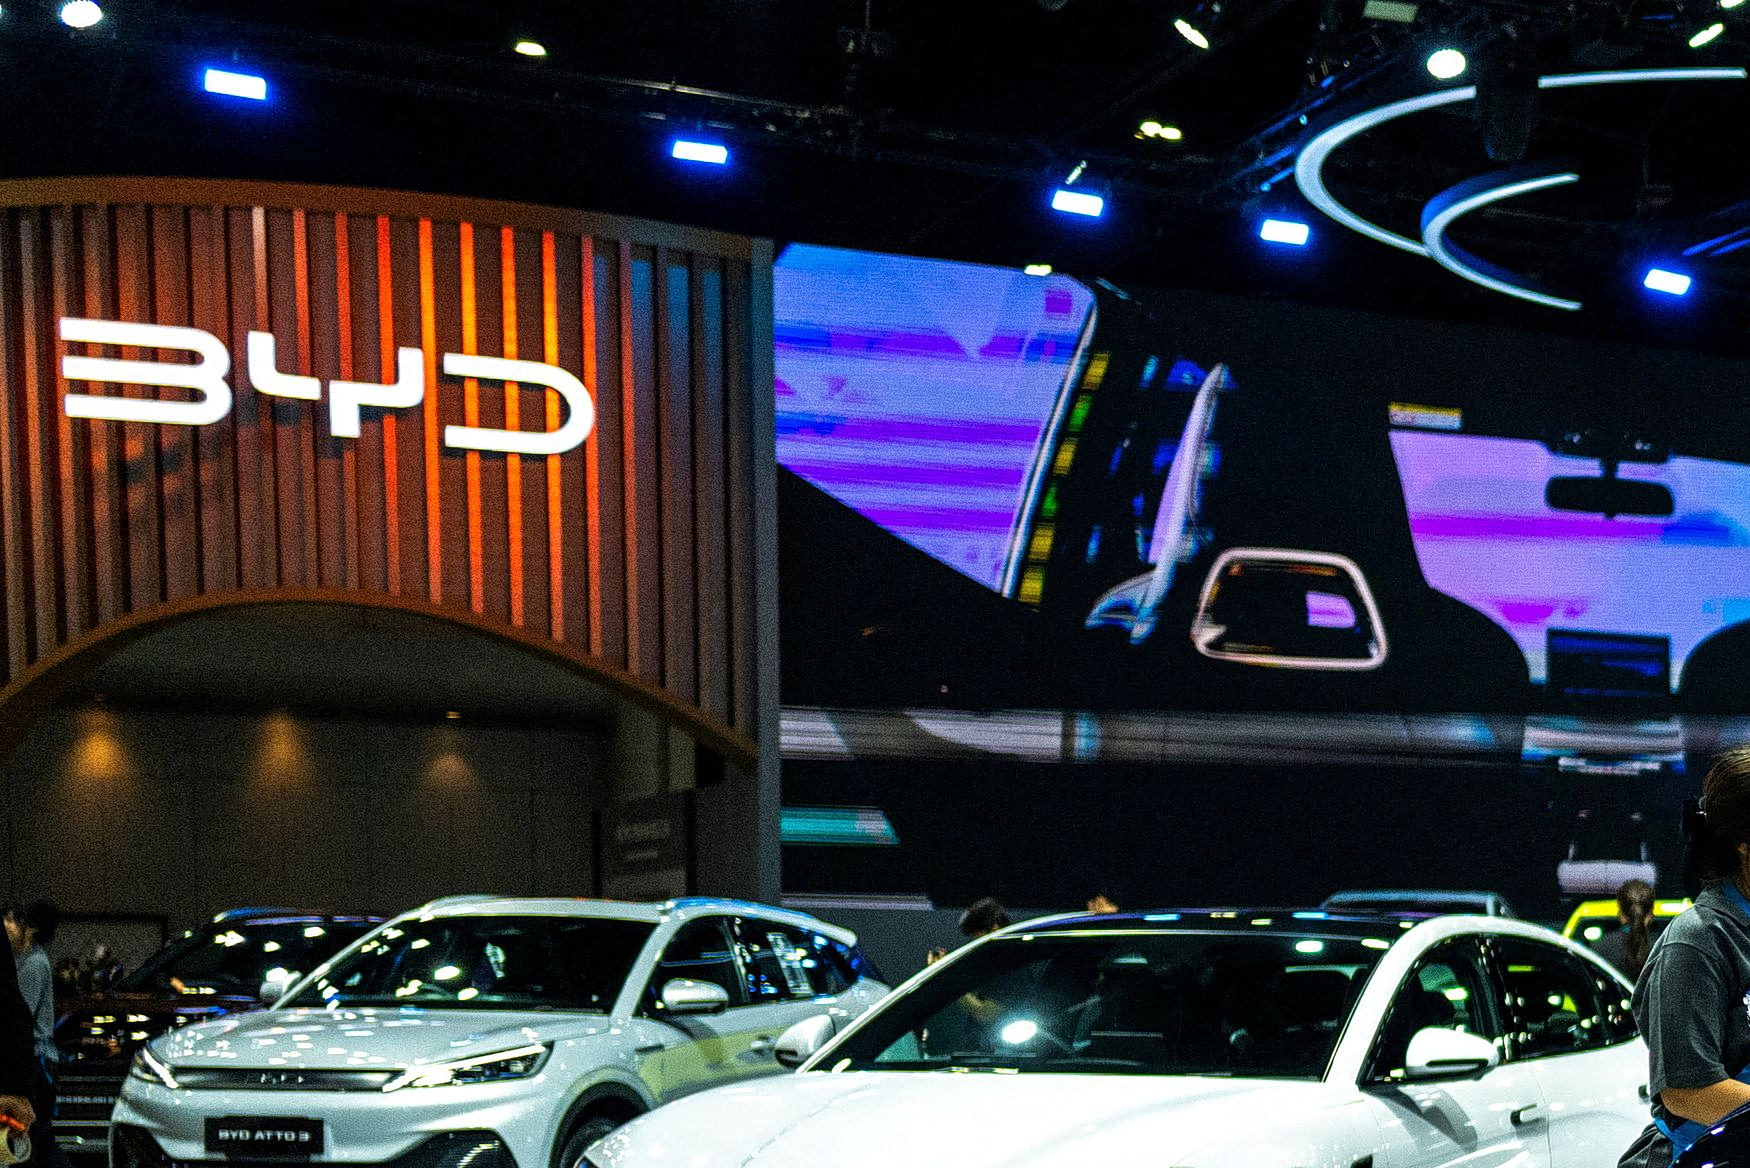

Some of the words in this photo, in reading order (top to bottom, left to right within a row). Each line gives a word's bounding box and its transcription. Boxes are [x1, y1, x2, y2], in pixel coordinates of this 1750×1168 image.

[60, 317, 594, 455] BYD
[219, 1129, 250, 1141] BYD
[255, 1130, 296, 1142] ATTO
[299, 1131, 310, 1142] 3
